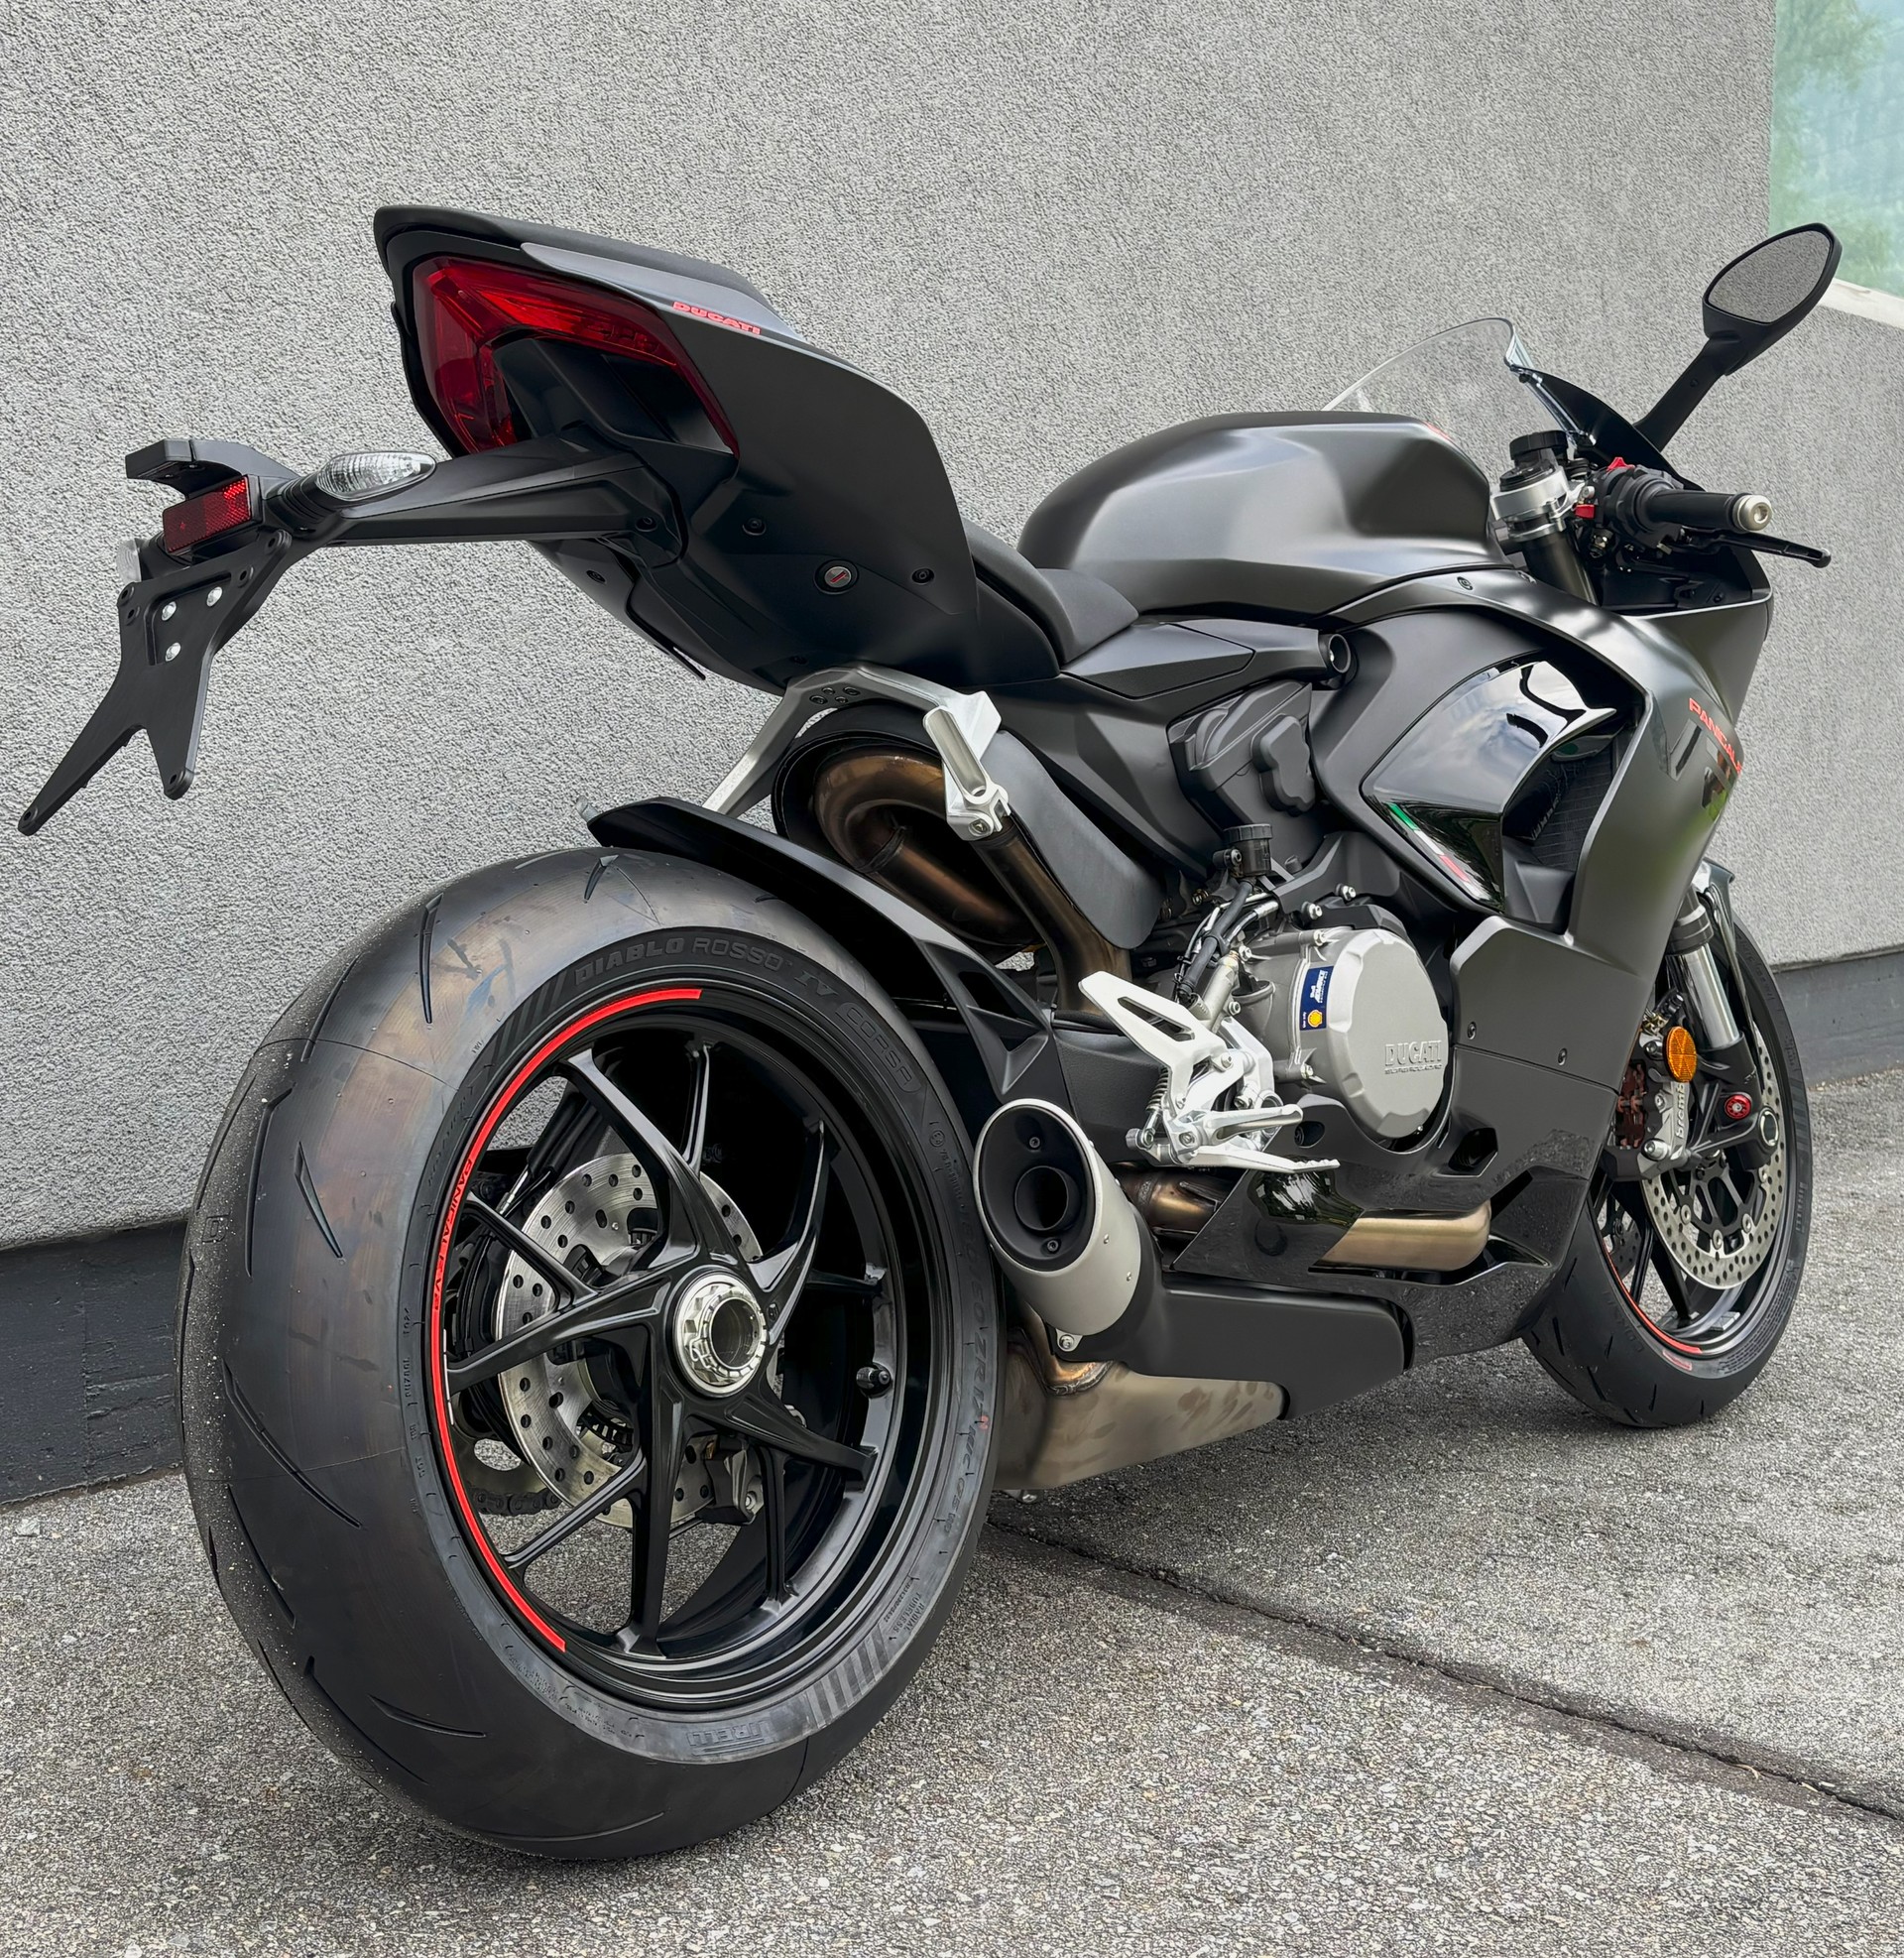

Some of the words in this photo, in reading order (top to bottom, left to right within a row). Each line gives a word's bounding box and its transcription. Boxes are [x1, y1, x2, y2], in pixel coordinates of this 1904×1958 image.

[672, 301, 762, 336] DUCATI
[574, 937, 686, 986] DIABLO
[692, 937, 784, 972] ROSSO
[794, 970, 839, 997] IV
[846, 1006, 913, 1088] CORSA
[1384, 1040, 1443, 1067] DUCATI
